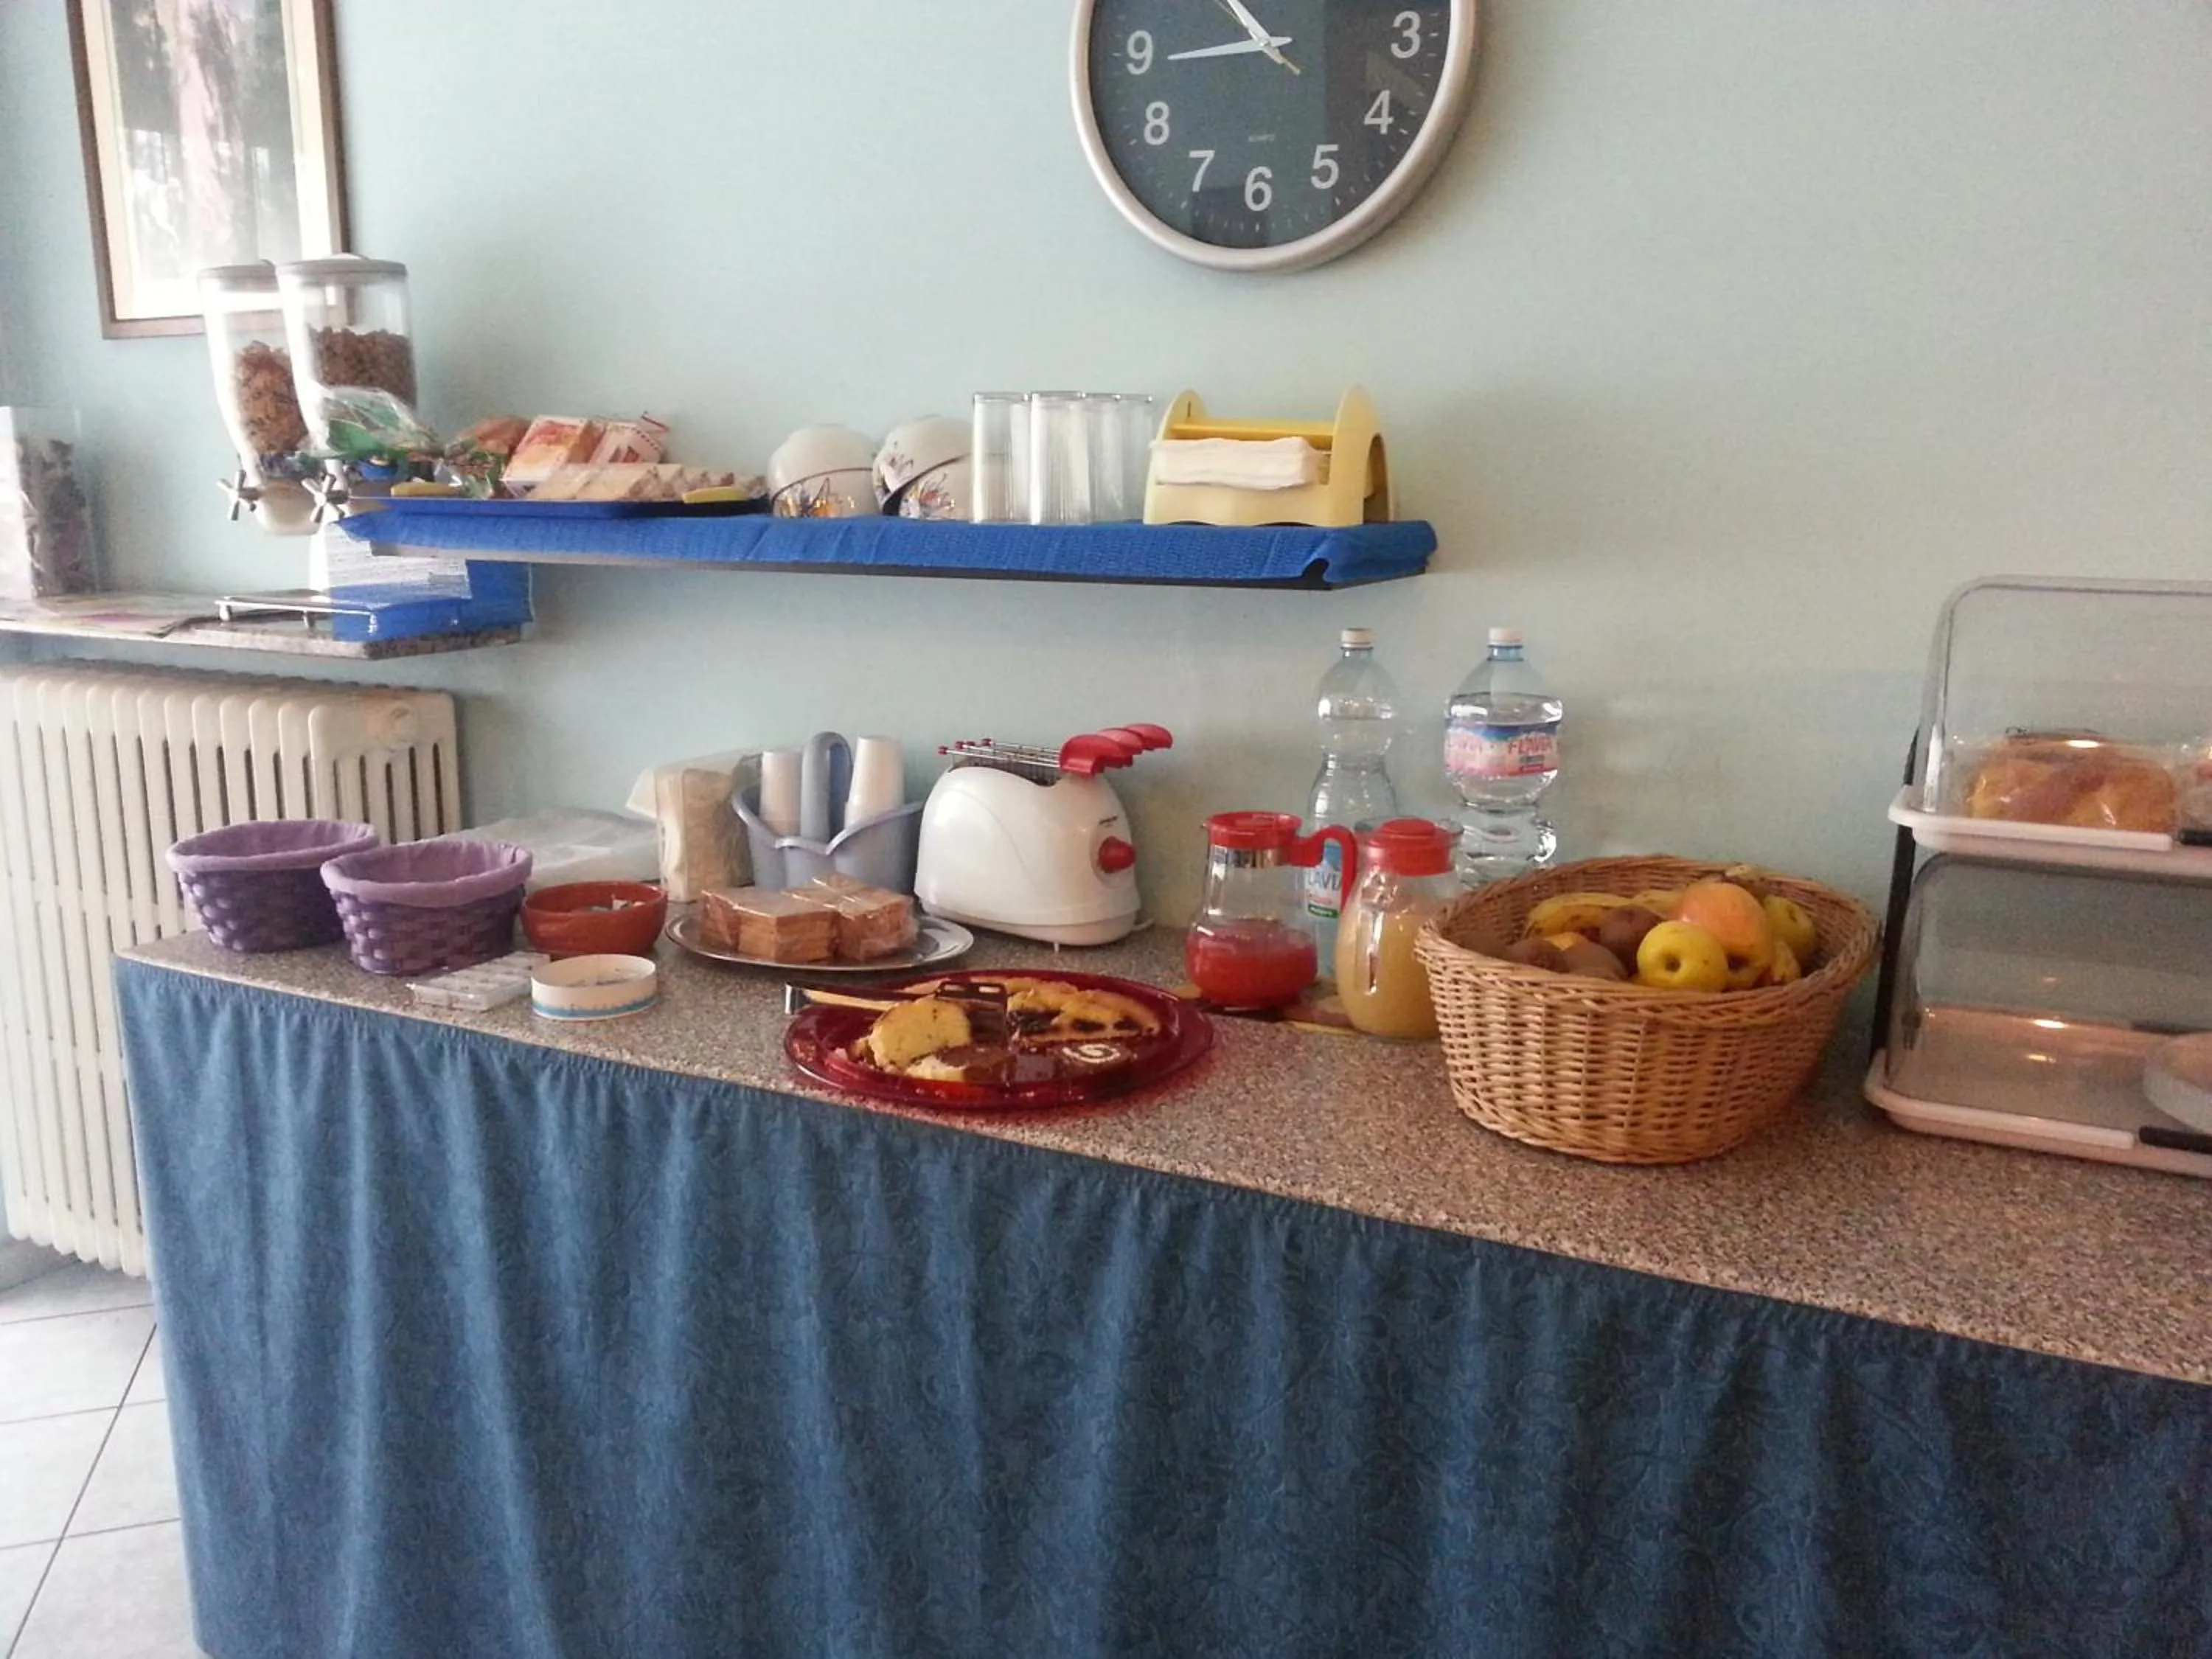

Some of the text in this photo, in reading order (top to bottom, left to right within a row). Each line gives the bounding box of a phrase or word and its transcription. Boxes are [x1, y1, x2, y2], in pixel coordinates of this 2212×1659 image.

[1127, 29, 1154, 75] 9
[1391, 10, 1421, 59] 3
[1144, 101, 1170, 145] 8
[1363, 88, 1394, 135] 4
[1189, 149, 1215, 192] 7
[1245, 166, 1273, 212] 6
[1310, 144, 1340, 189] 5
